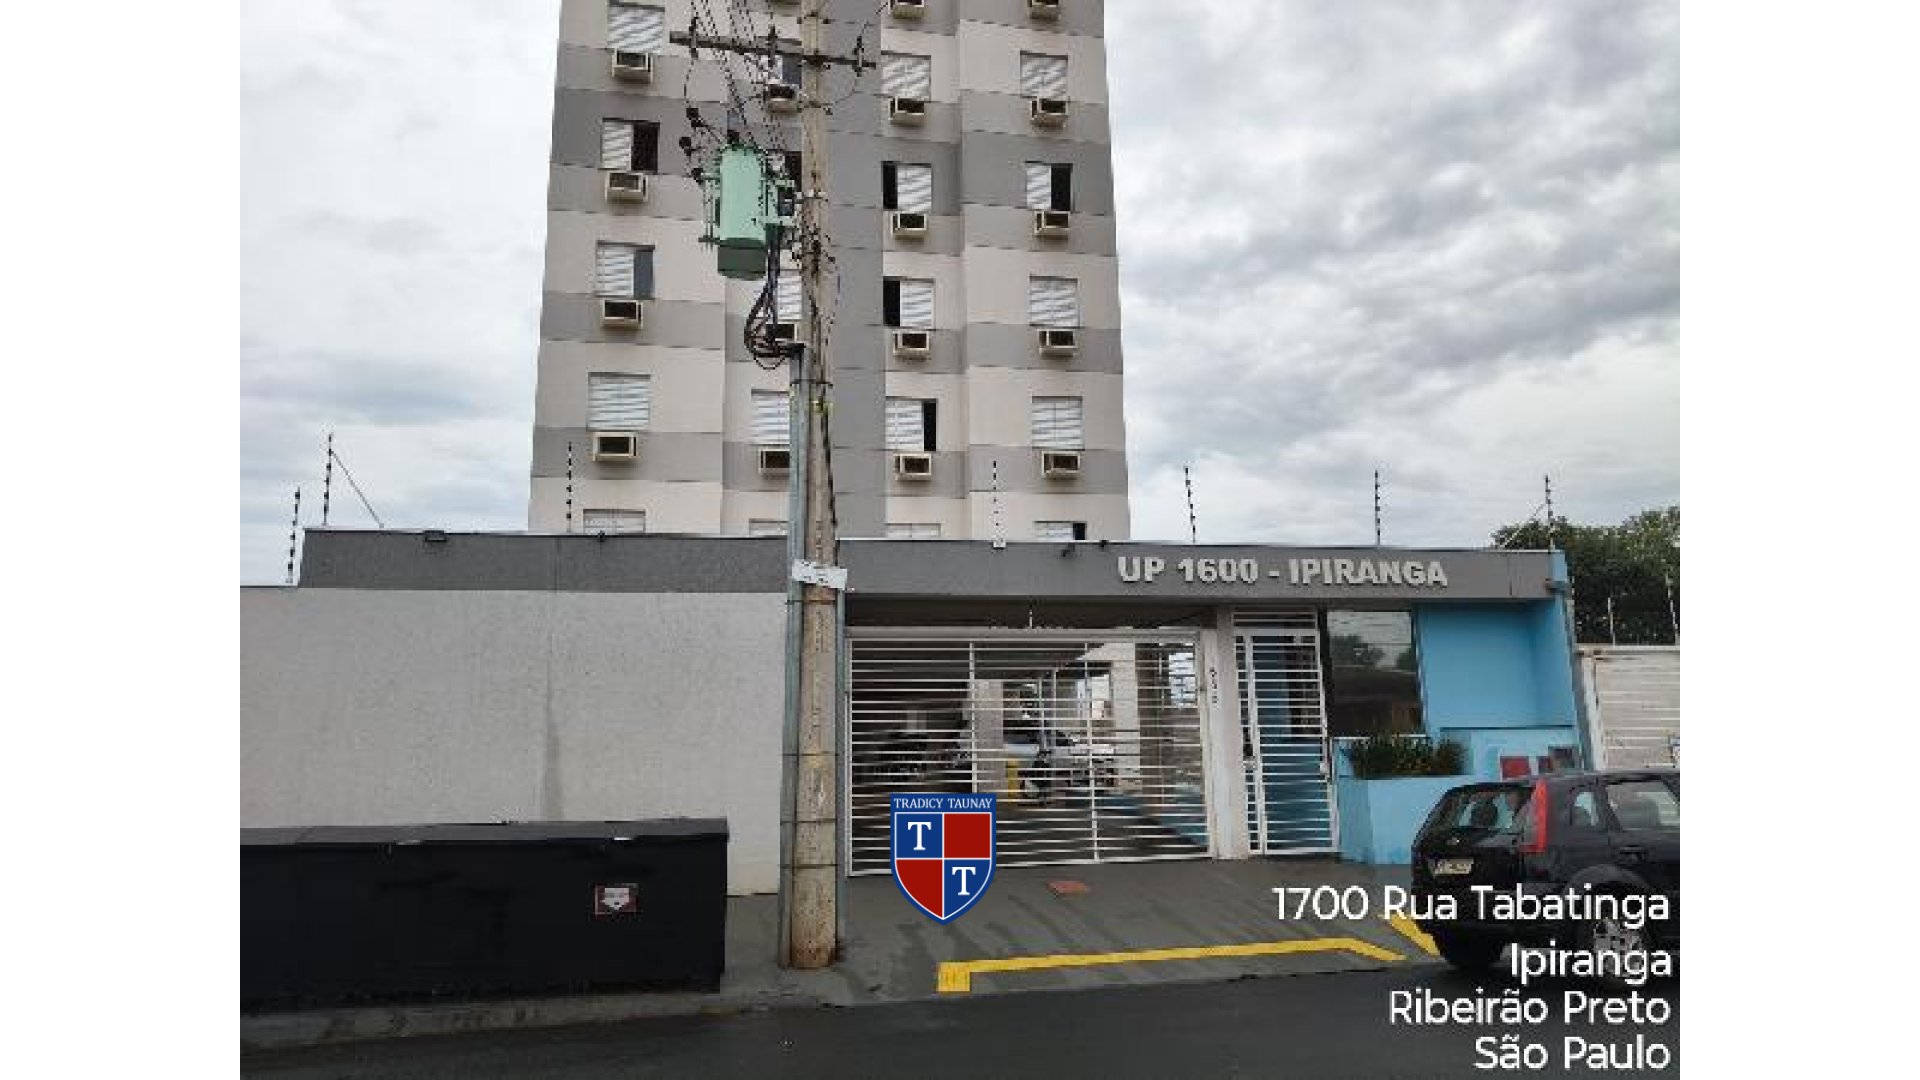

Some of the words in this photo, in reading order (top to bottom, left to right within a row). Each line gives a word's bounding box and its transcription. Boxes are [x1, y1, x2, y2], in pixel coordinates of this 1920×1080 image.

[1117, 556, 1165, 583] UP
[1177, 557, 1259, 585] 1600
[1268, 569, 1281, 579] -
[1287, 557, 1449, 588] IPIRANGA
